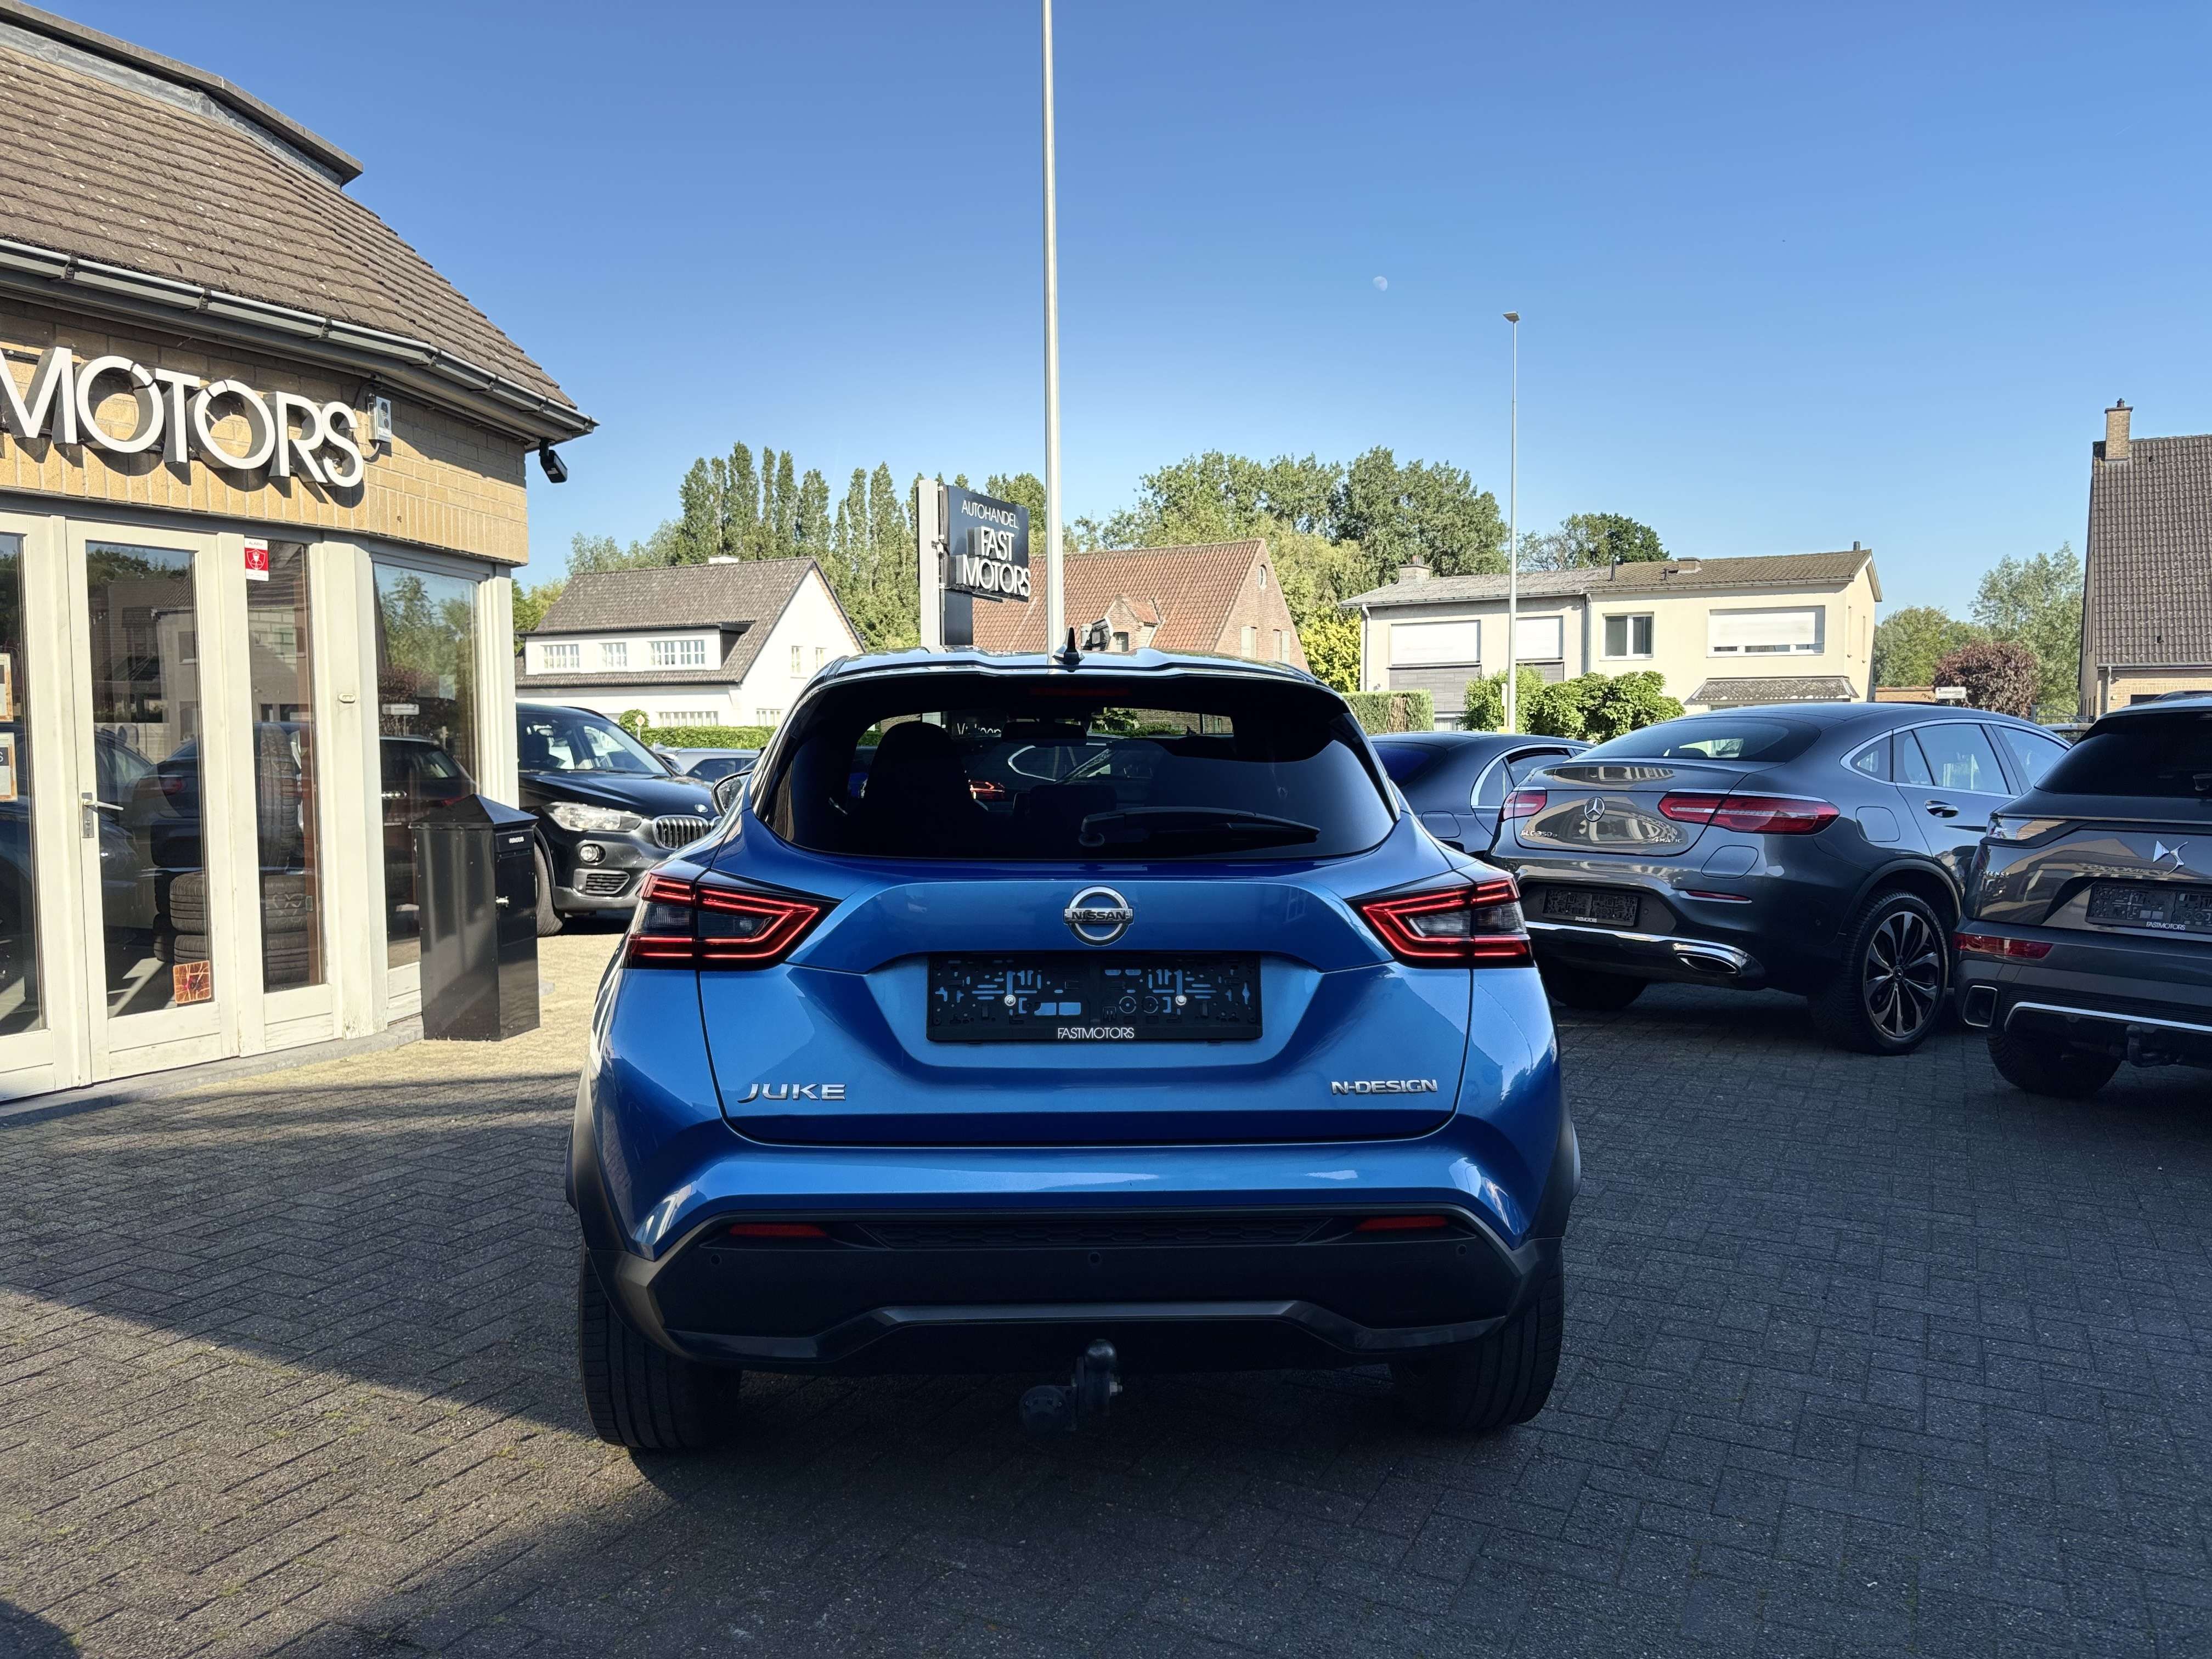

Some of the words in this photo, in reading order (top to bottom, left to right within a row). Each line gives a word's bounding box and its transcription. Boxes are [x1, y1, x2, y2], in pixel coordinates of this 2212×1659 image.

[0, 347, 364, 487] MOTORS
[961, 500, 1018, 529] AUTOHANDEL
[980, 526, 1015, 562] FAST
[962, 554, 1031, 597] MOTORS
[1071, 911, 1127, 921] NISSAN
[2146, 921, 2186, 931] FASTMOTORS
[1058, 1027, 1135, 1039] FASTMOTORS
[737, 1083, 846, 1104] JUKE
[1331, 1079, 1438, 1094] N-DESIGN
